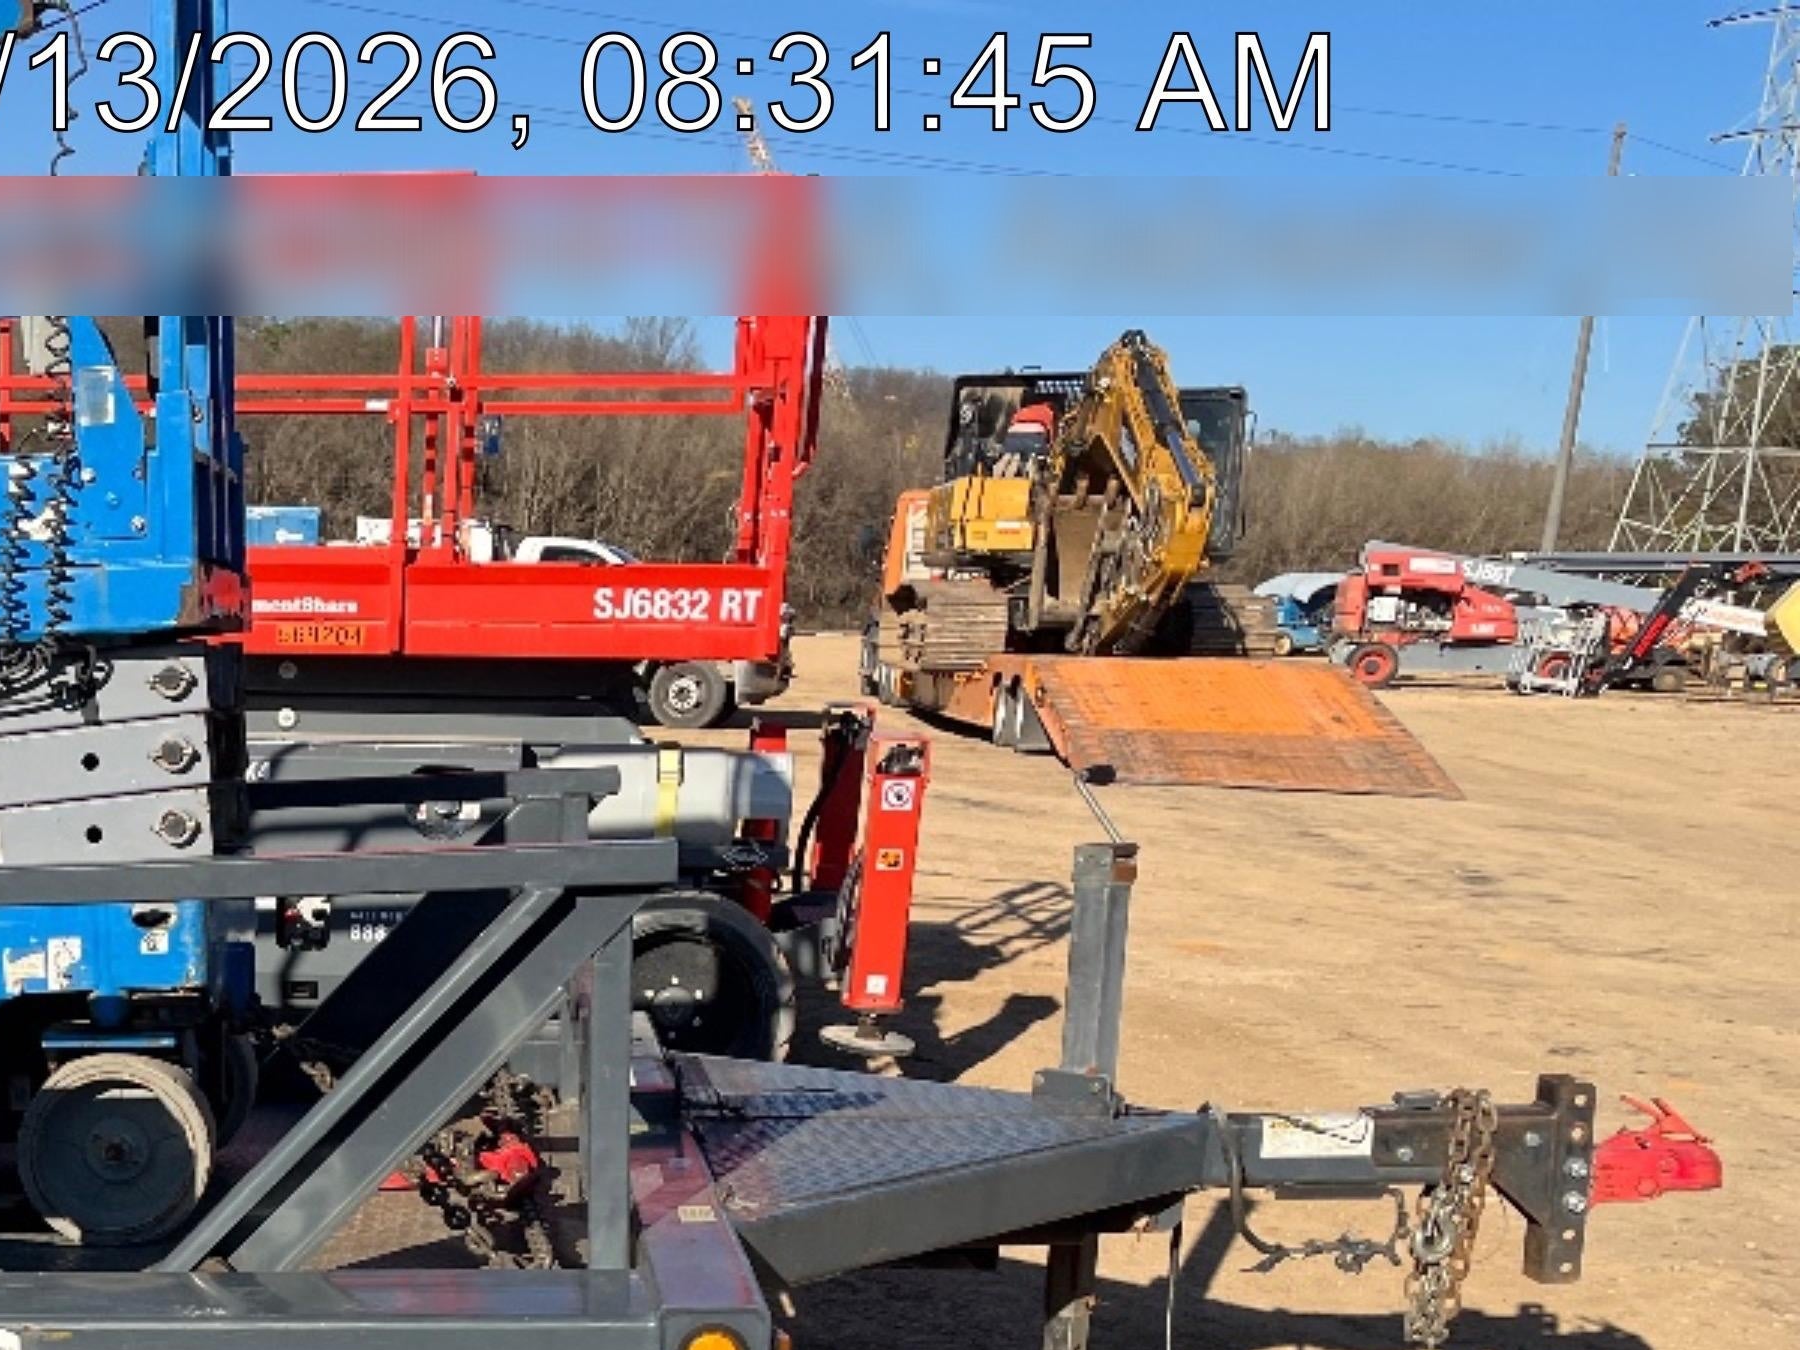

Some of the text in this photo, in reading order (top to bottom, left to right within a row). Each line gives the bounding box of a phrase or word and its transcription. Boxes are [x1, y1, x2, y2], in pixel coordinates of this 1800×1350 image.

[252, 596, 358, 613] mentShare
[593, 587, 763, 622] SJ6832 RT
